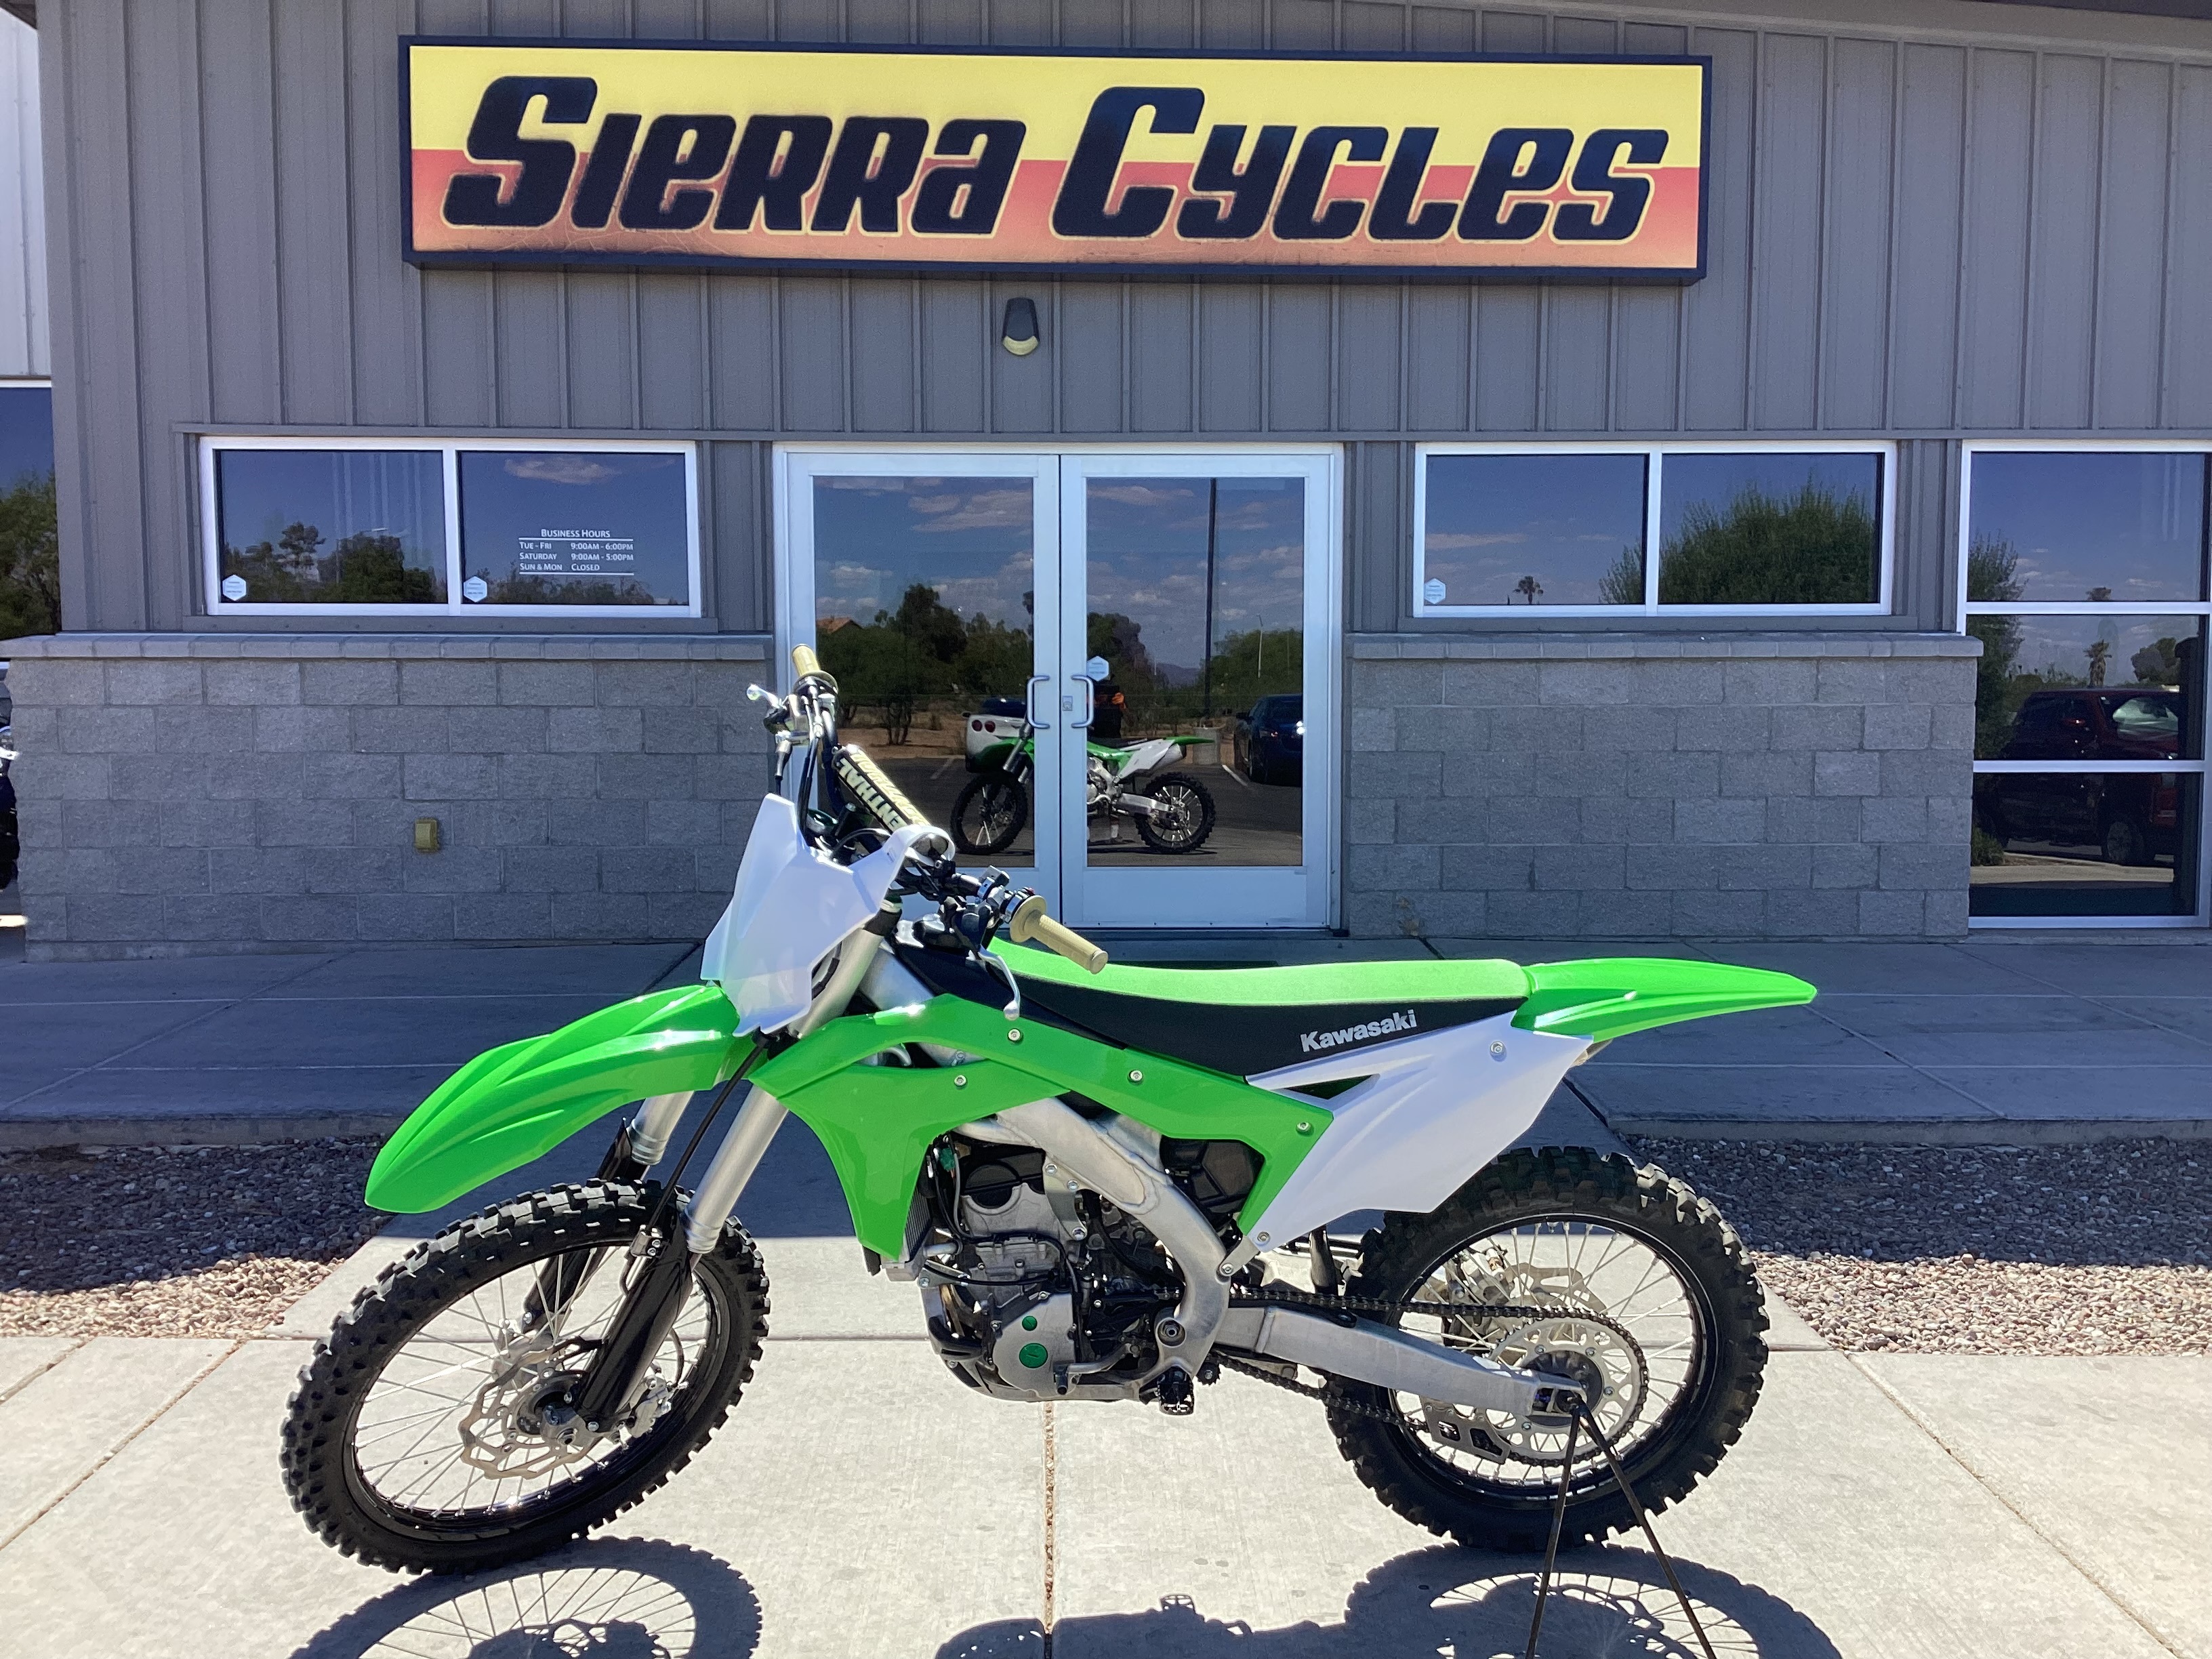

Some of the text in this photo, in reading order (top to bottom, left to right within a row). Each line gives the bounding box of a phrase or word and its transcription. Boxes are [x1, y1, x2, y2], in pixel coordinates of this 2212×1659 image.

[541, 529, 611, 537] BUSINESS HOURS
[519, 541, 534, 550] TUE
[539, 541, 552, 550] FRI
[520, 562, 535, 571] SUN
[571, 563, 600, 571] CLOSED
[838, 756, 908, 833] ENTHAL
[1300, 1009, 1417, 1052] Kawasaki
